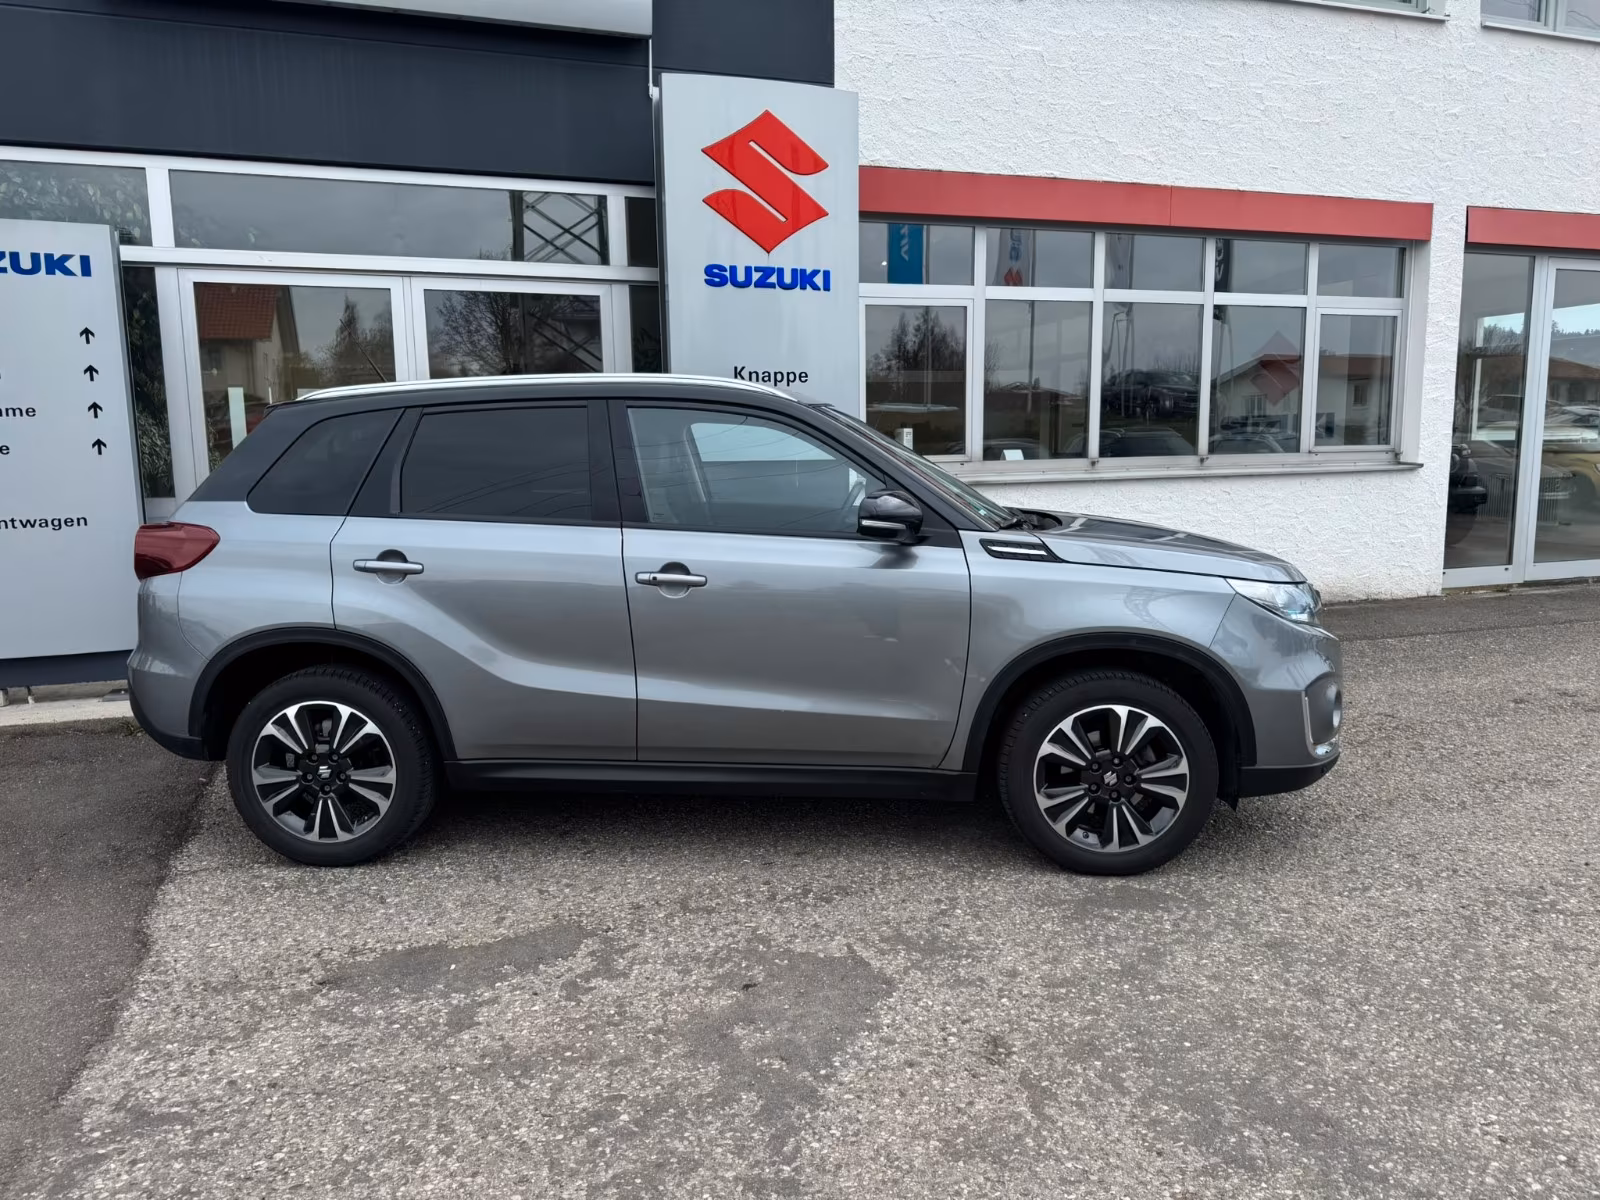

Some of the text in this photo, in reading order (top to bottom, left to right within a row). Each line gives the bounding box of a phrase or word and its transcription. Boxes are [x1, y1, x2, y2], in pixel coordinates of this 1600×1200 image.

[0, 251, 92, 277] UKI
[703, 263, 831, 292] SUZUKI
[733, 365, 809, 387] Knappe
[0, 407, 37, 418] me
[0, 516, 88, 531] ntwagen
